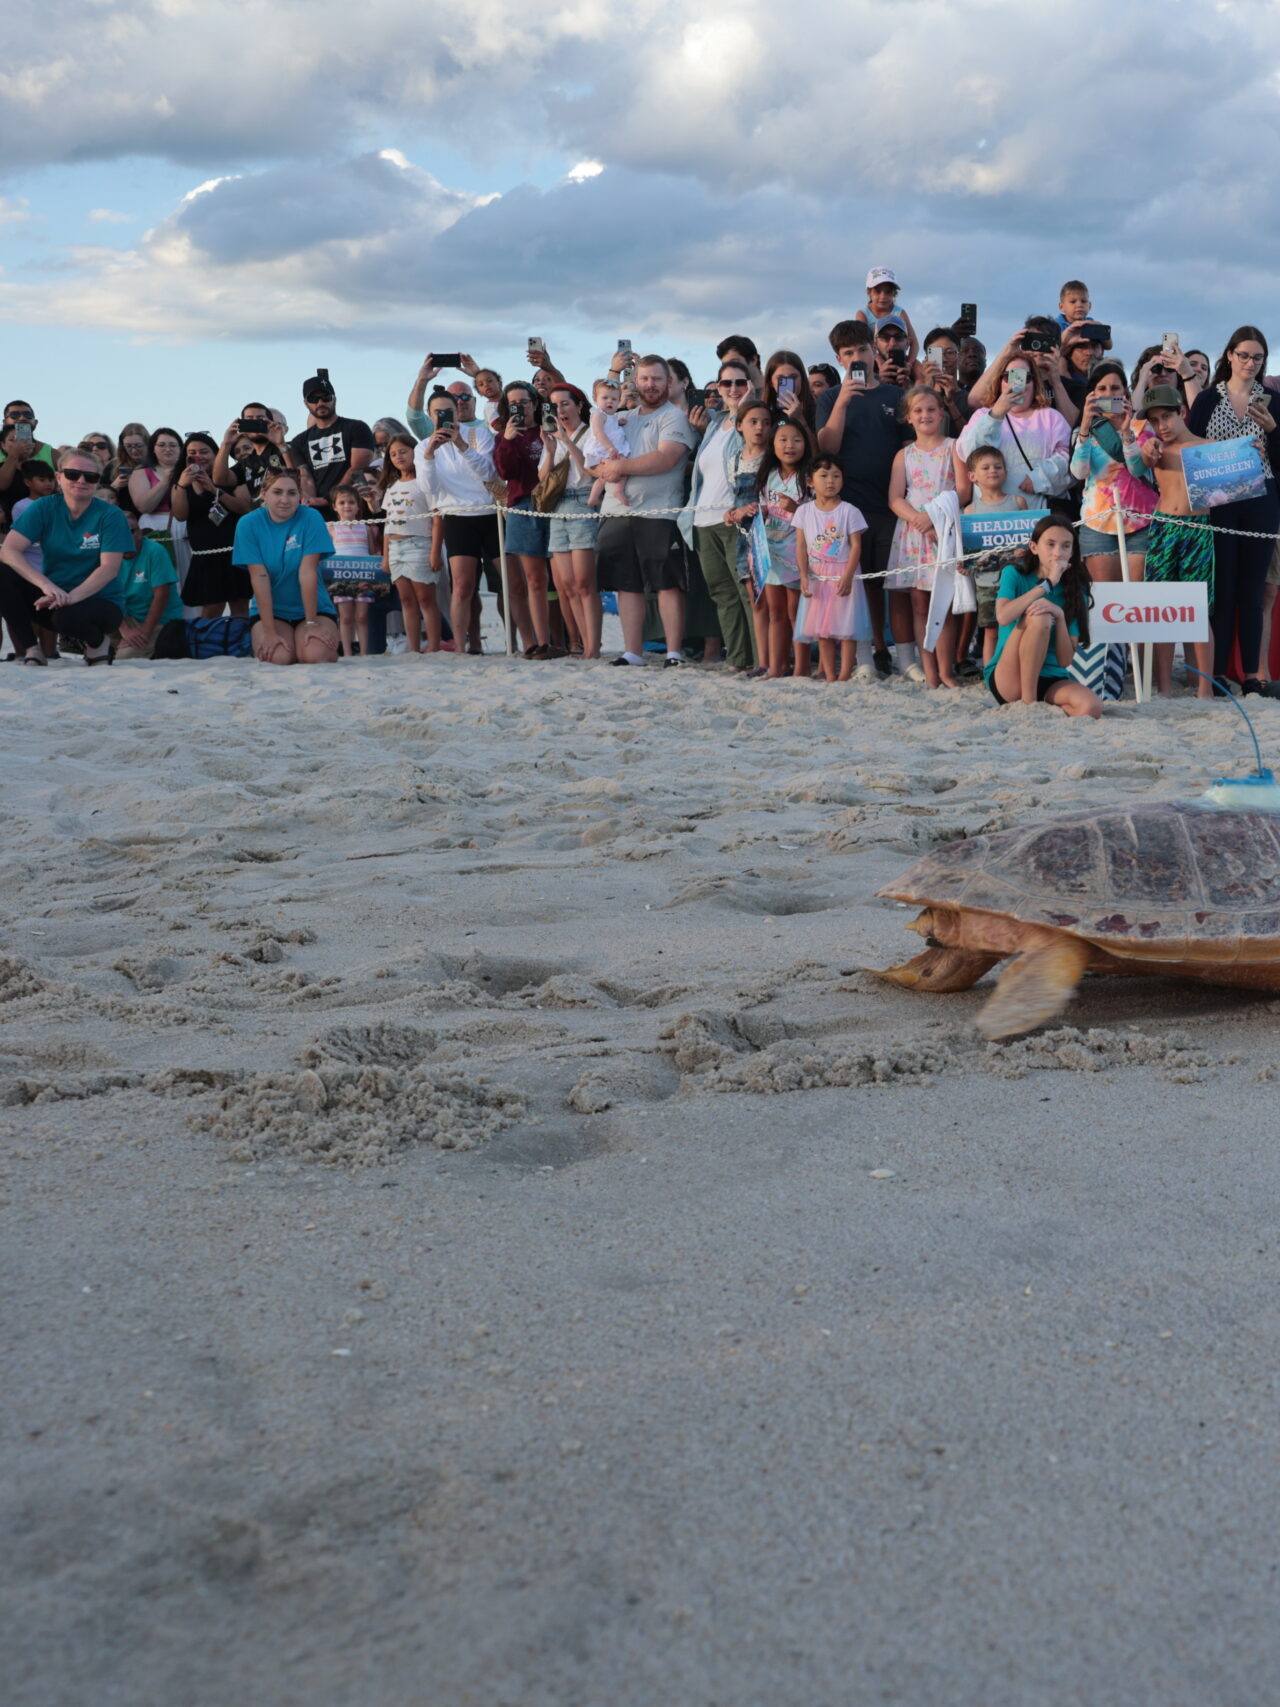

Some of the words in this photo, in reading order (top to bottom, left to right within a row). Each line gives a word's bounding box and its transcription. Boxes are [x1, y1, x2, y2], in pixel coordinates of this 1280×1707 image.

[1206, 450, 1236, 464] WEAR
[1193, 459, 1255, 481] SUNSCREEN!
[333, 570, 376, 580] HOME!
[1102, 603, 1195, 623] Canon
